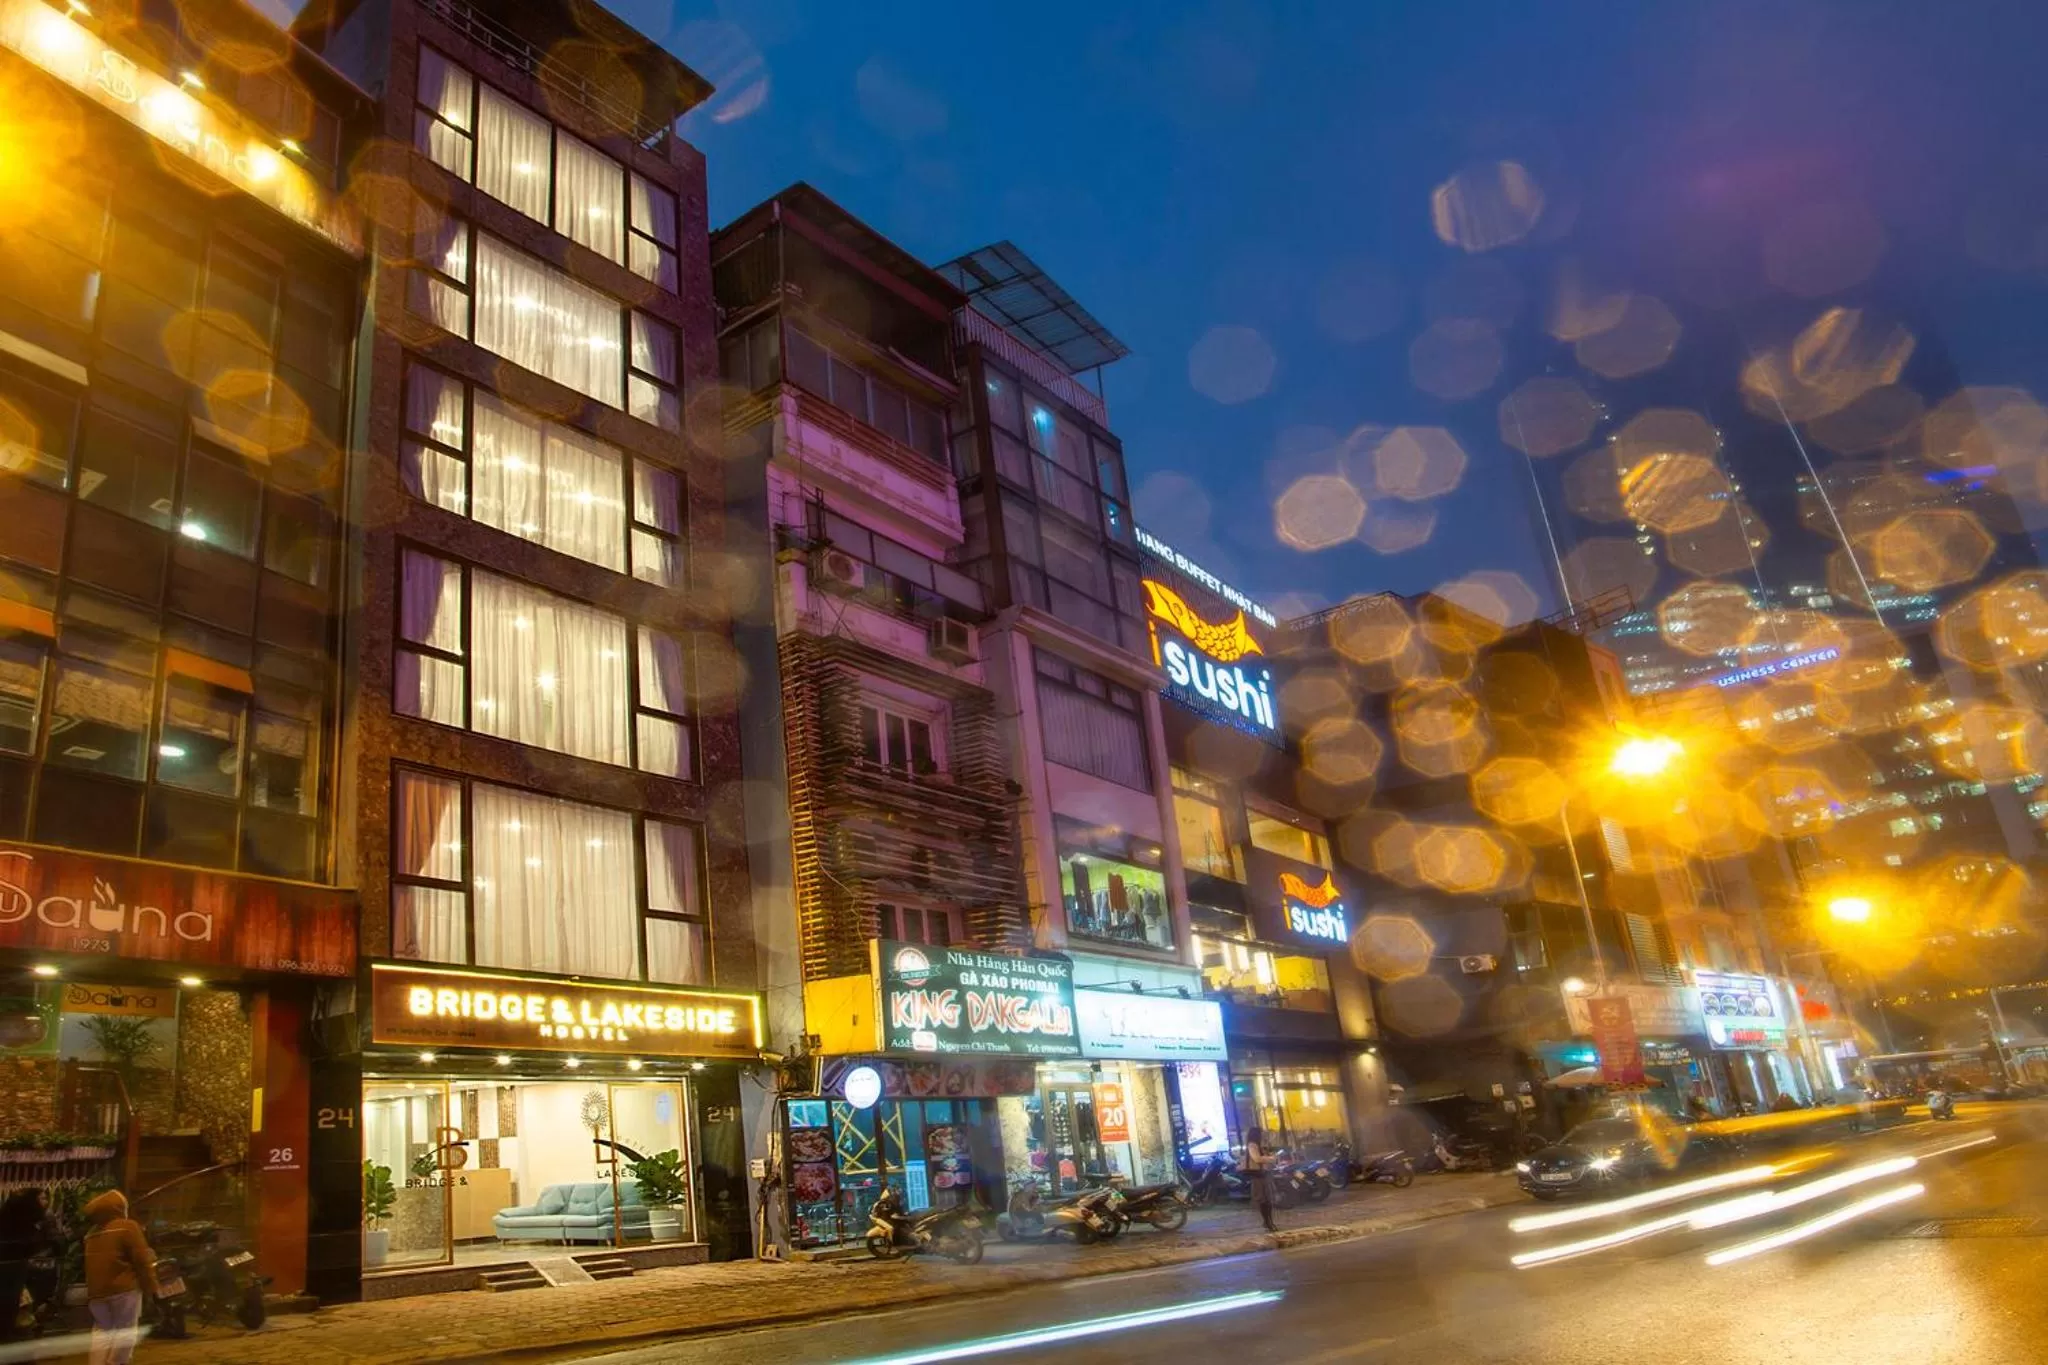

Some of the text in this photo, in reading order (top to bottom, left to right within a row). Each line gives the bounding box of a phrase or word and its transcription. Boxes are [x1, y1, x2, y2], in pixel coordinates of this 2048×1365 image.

[1174, 553, 1221, 594] BUFFET
[1780, 648, 1838, 671] CENTER
[72, 937, 111, 953] 1973
[409, 985, 737, 1034] BRIDGE & LAKESIDE
[891, 989, 961, 1030] KING
[317, 1107, 354, 1129] 24
[707, 1106, 735, 1123] 24
[1102, 1107, 1125, 1127] 20
[269, 1148, 293, 1163] 26
[405, 1177, 455, 1189] BRIDGE
